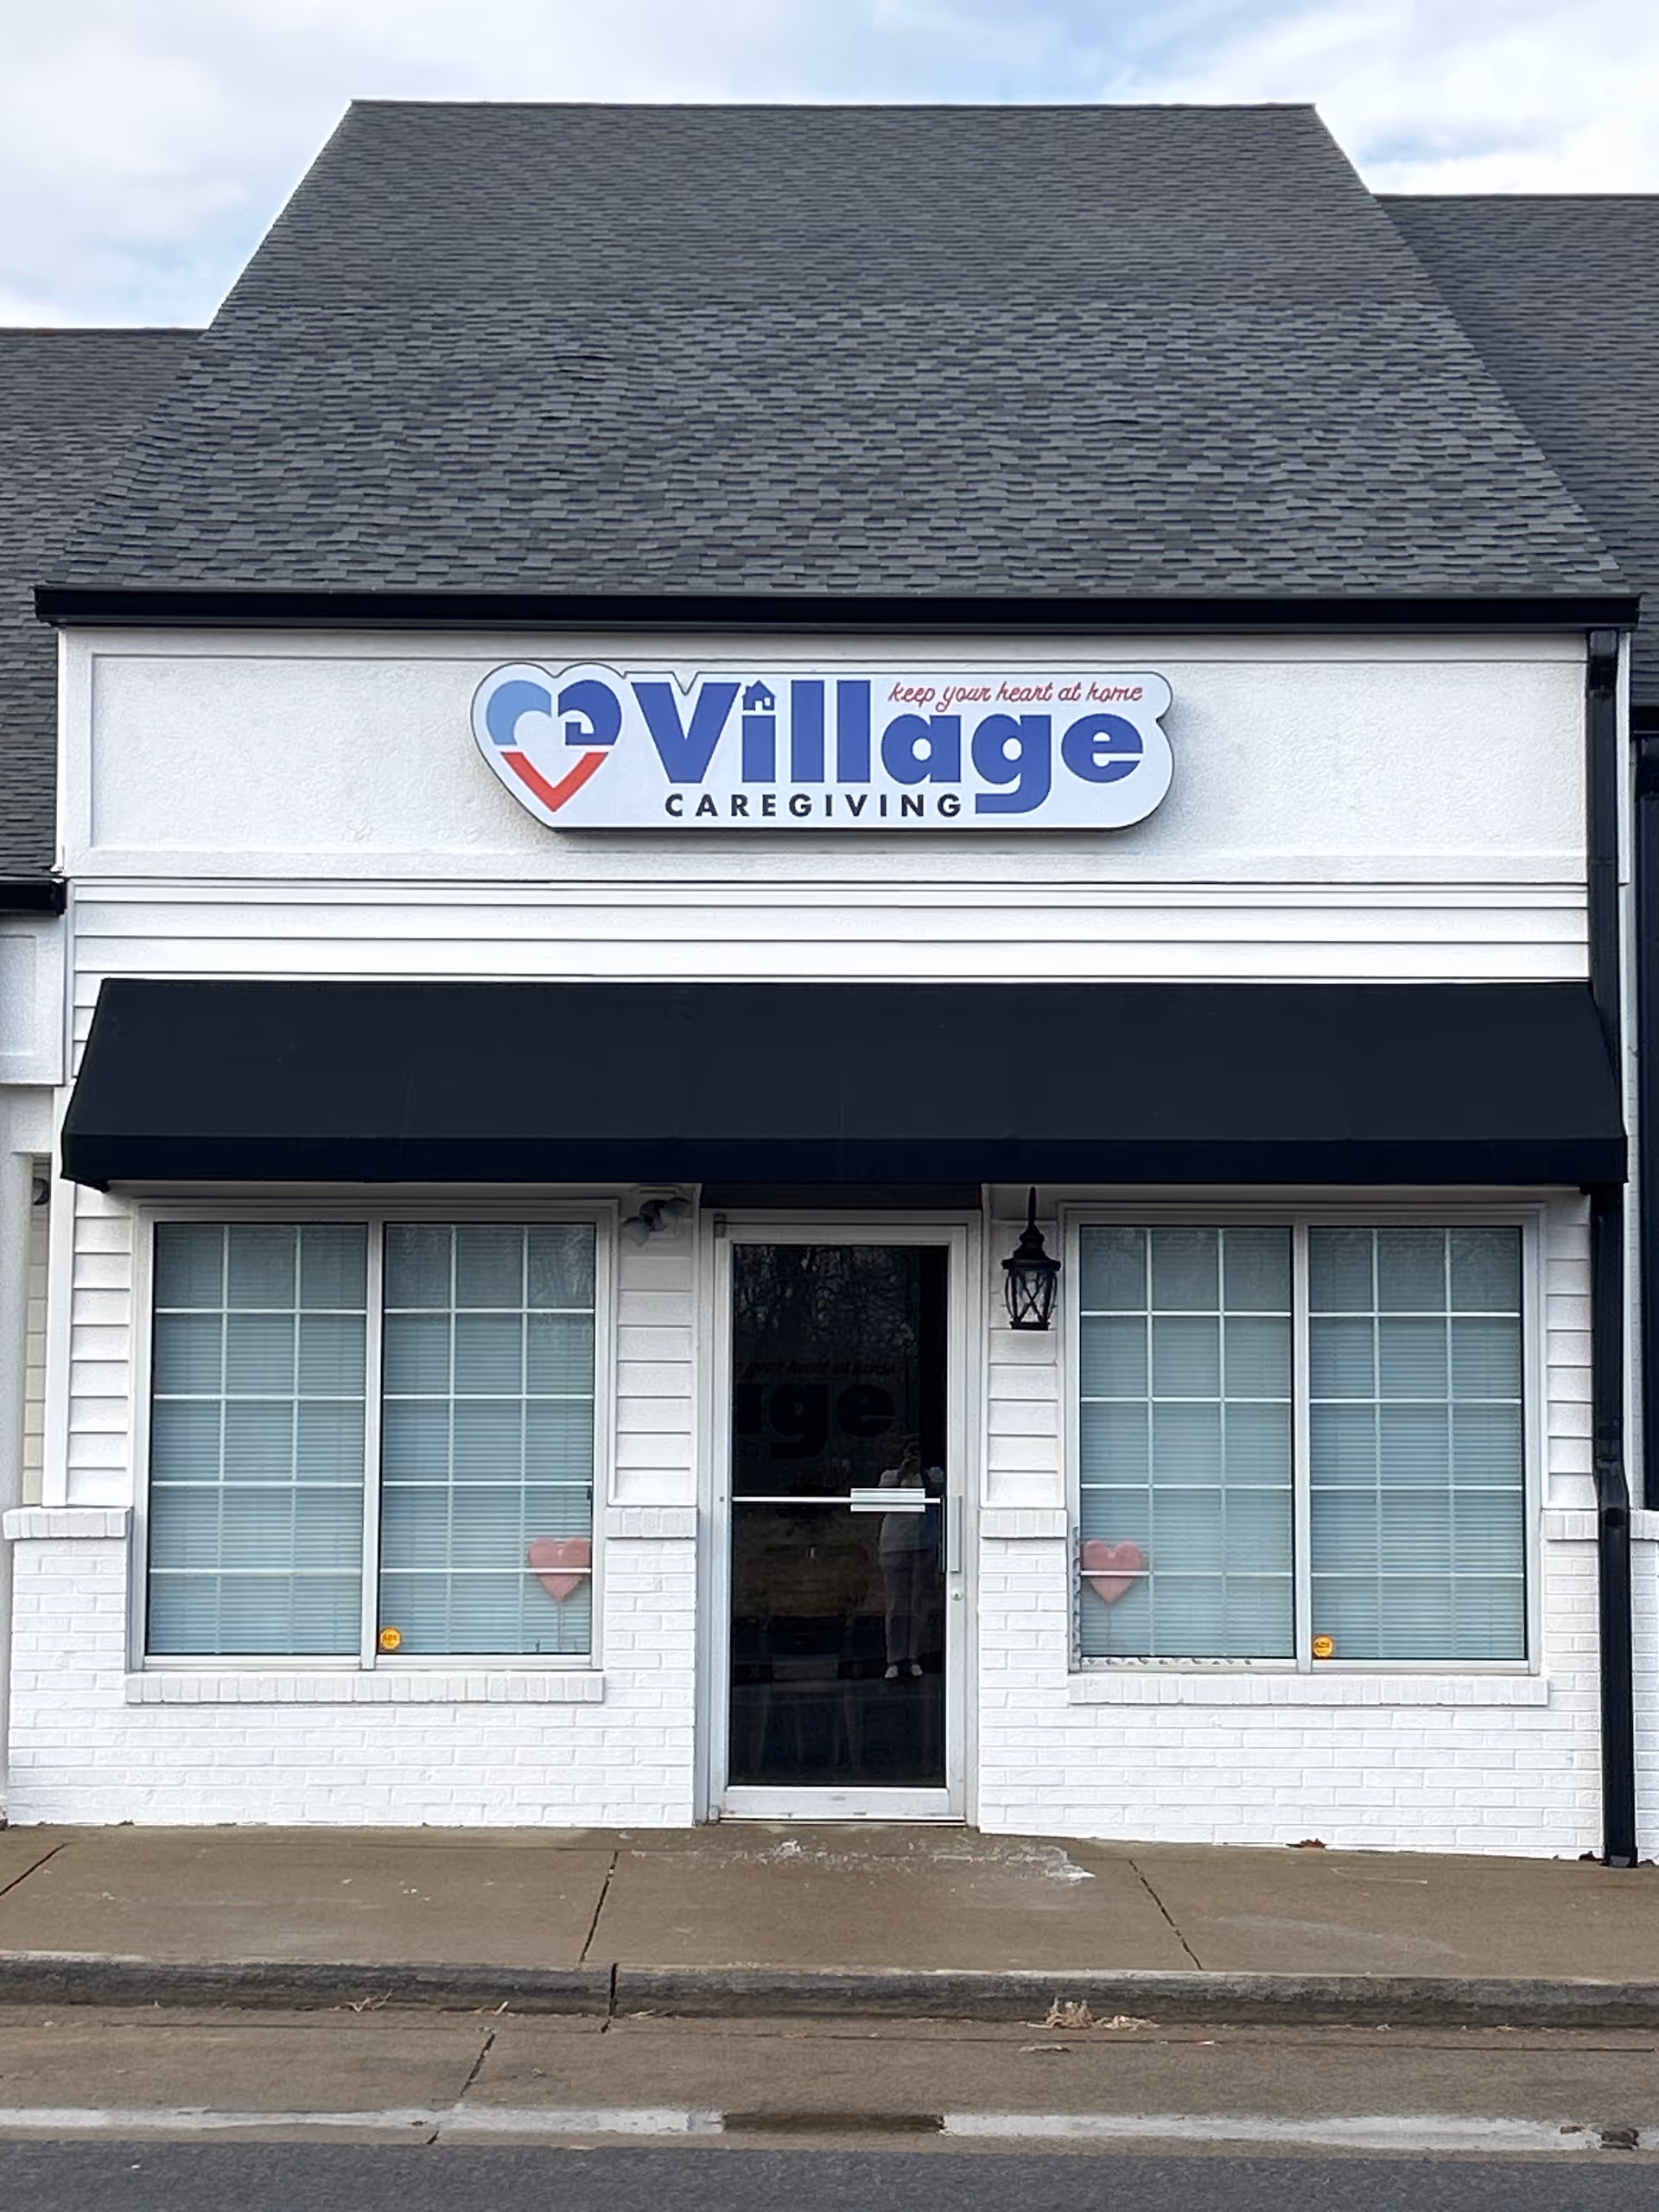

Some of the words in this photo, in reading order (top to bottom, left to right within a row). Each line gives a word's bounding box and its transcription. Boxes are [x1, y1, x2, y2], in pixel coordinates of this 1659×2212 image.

[888, 682, 935, 708] keep
[935, 685, 991, 713] your
[995, 681, 1053, 702] heart
[1058, 682, 1081, 702] at
[1085, 682, 1142, 702] home
[631, 680, 1143, 813] Village
[665, 793, 961, 817] CAREGIVING
